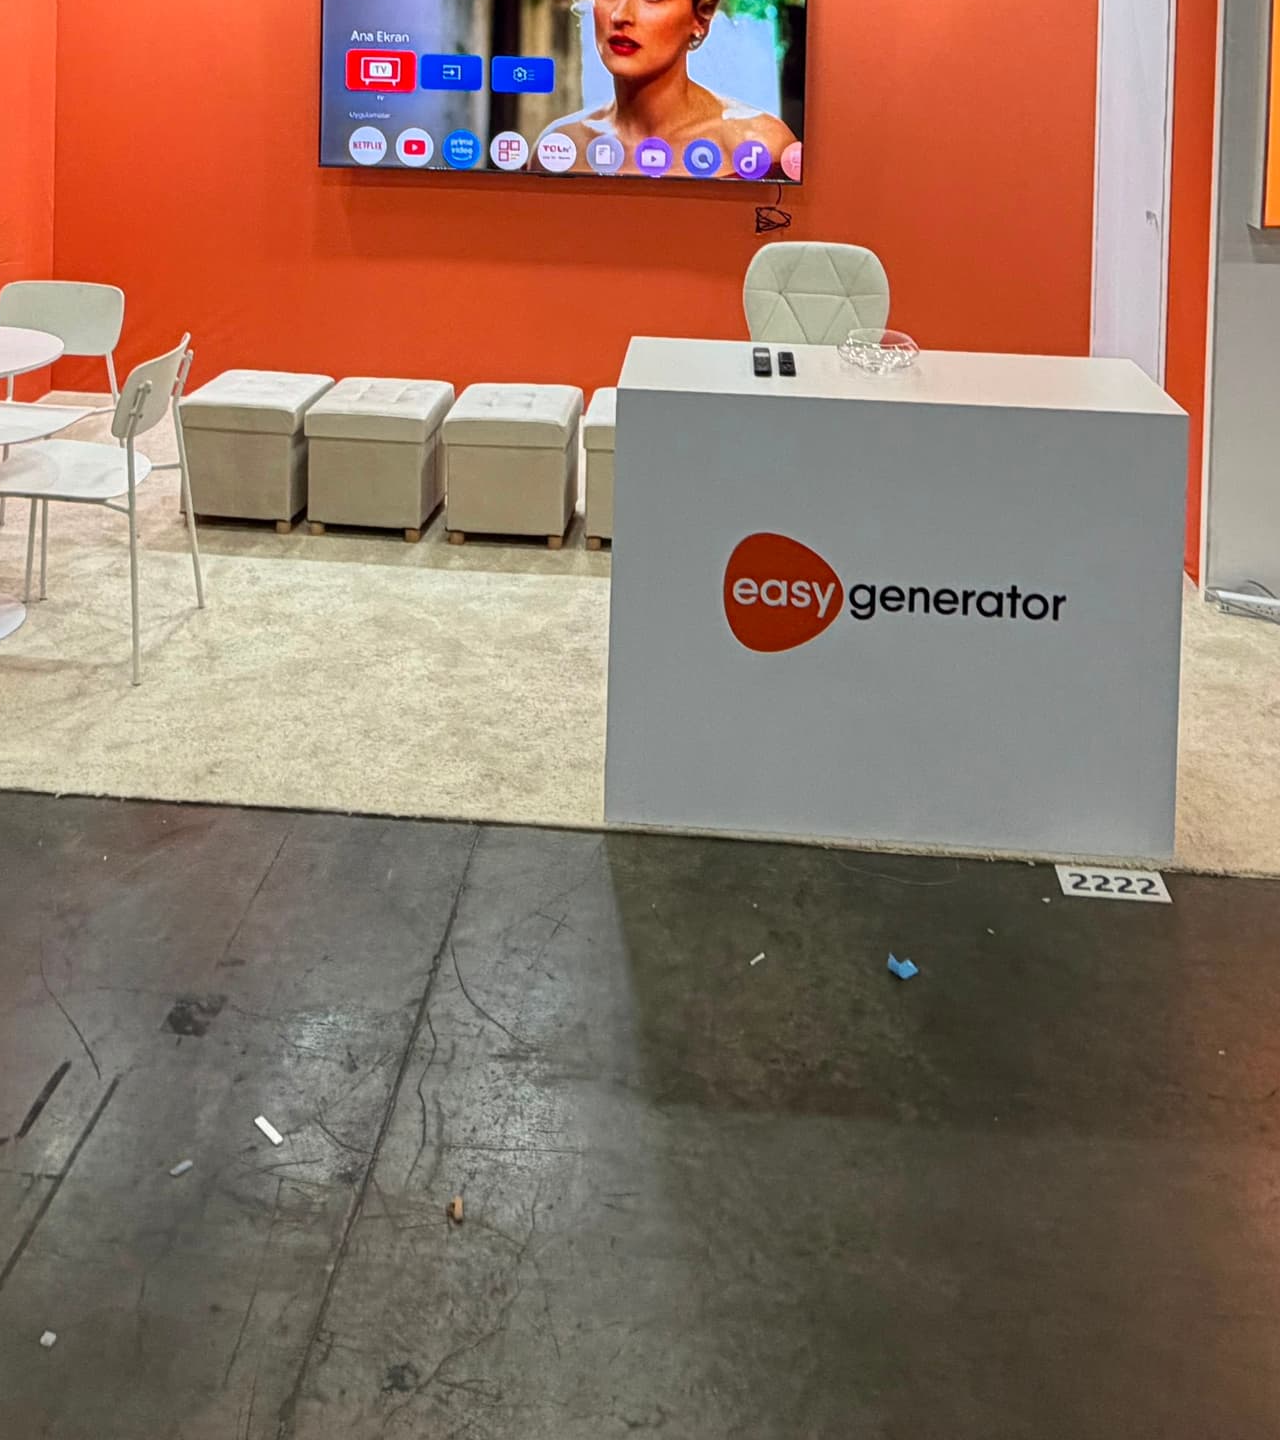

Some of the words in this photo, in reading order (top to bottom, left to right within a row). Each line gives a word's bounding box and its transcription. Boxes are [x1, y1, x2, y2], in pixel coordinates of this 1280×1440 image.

[350, 30, 374, 42] Ana
[376, 31, 410, 43] Ekran
[353, 141, 383, 151] NETFLIX
[450, 139, 473, 147] prime
[451, 147, 473, 155] video
[732, 577, 835, 618] easy
[849, 584, 1067, 621] generator
[1068, 872, 1161, 896] 2222
